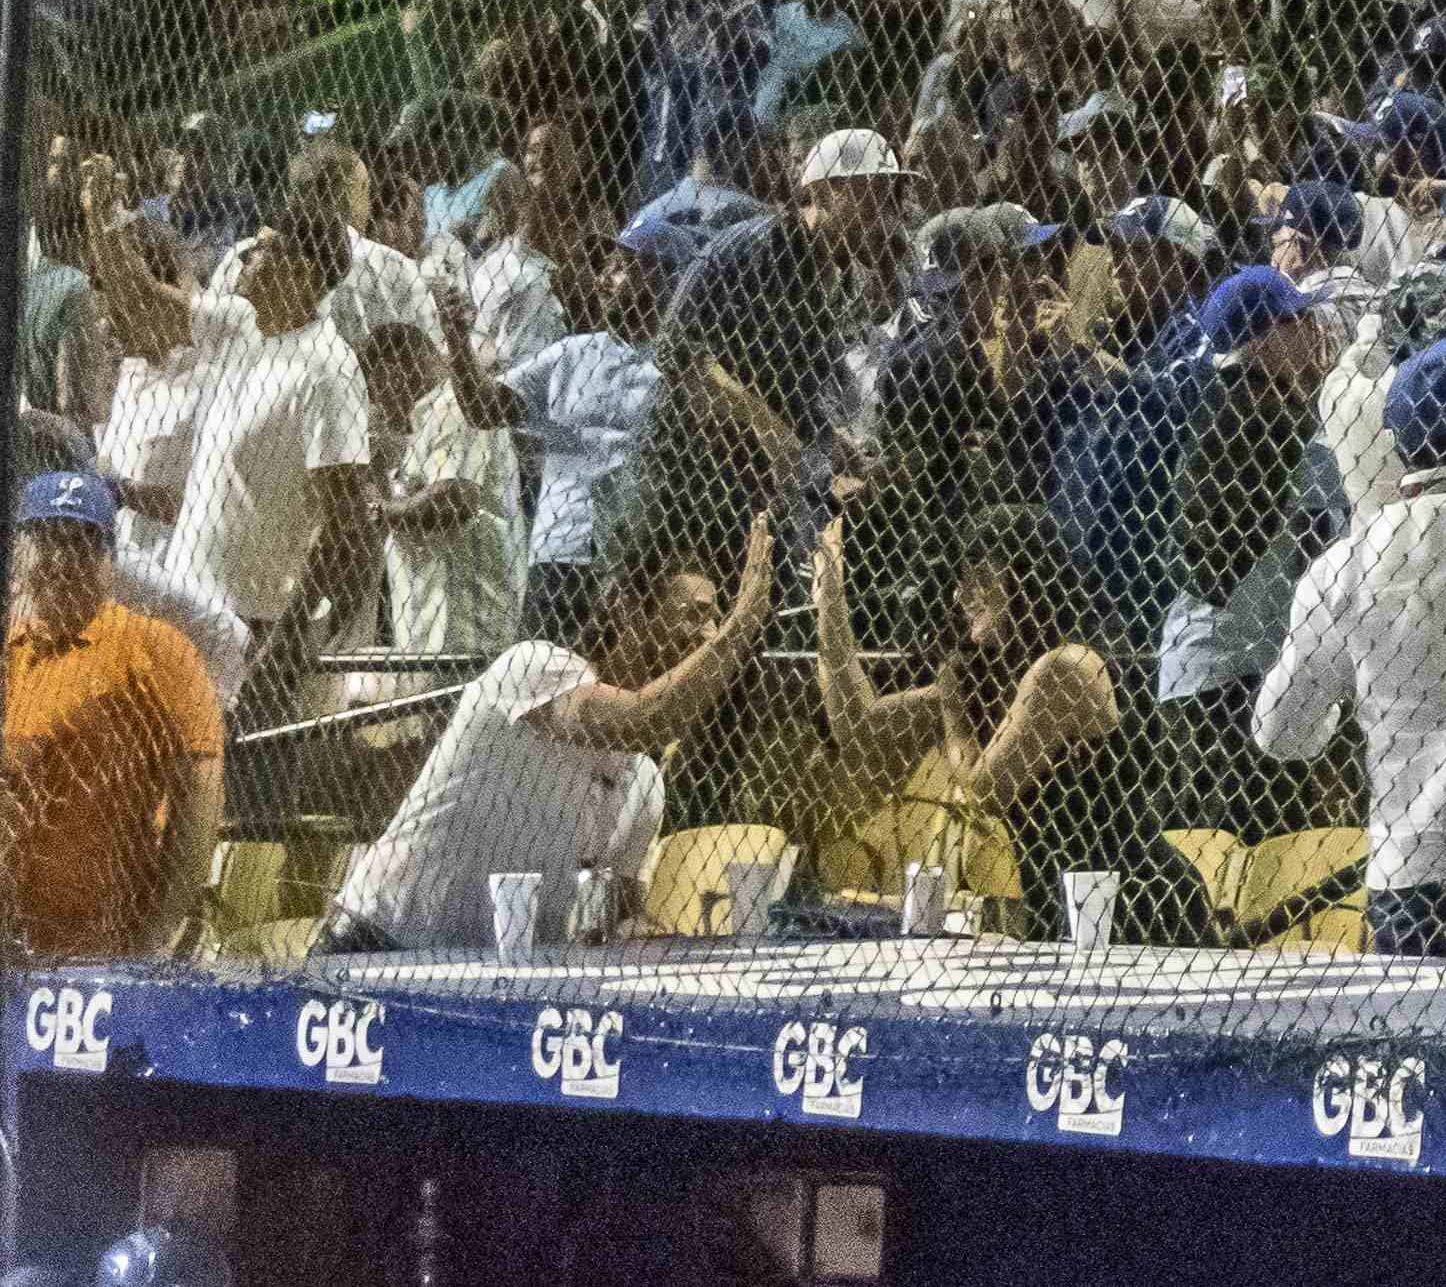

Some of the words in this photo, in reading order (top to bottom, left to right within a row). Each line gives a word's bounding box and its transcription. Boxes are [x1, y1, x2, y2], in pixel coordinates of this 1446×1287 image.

[49, 476, 84, 508] L
[27, 987, 113, 1054] GBC
[297, 1000, 386, 1067] GBC
[531, 1007, 624, 1080] GBC
[773, 1020, 868, 1097] GBC
[1026, 1033, 1129, 1115] GBC
[1312, 1054, 1426, 1139] GBC
[1359, 1143, 1414, 1159] FARMACIAS
